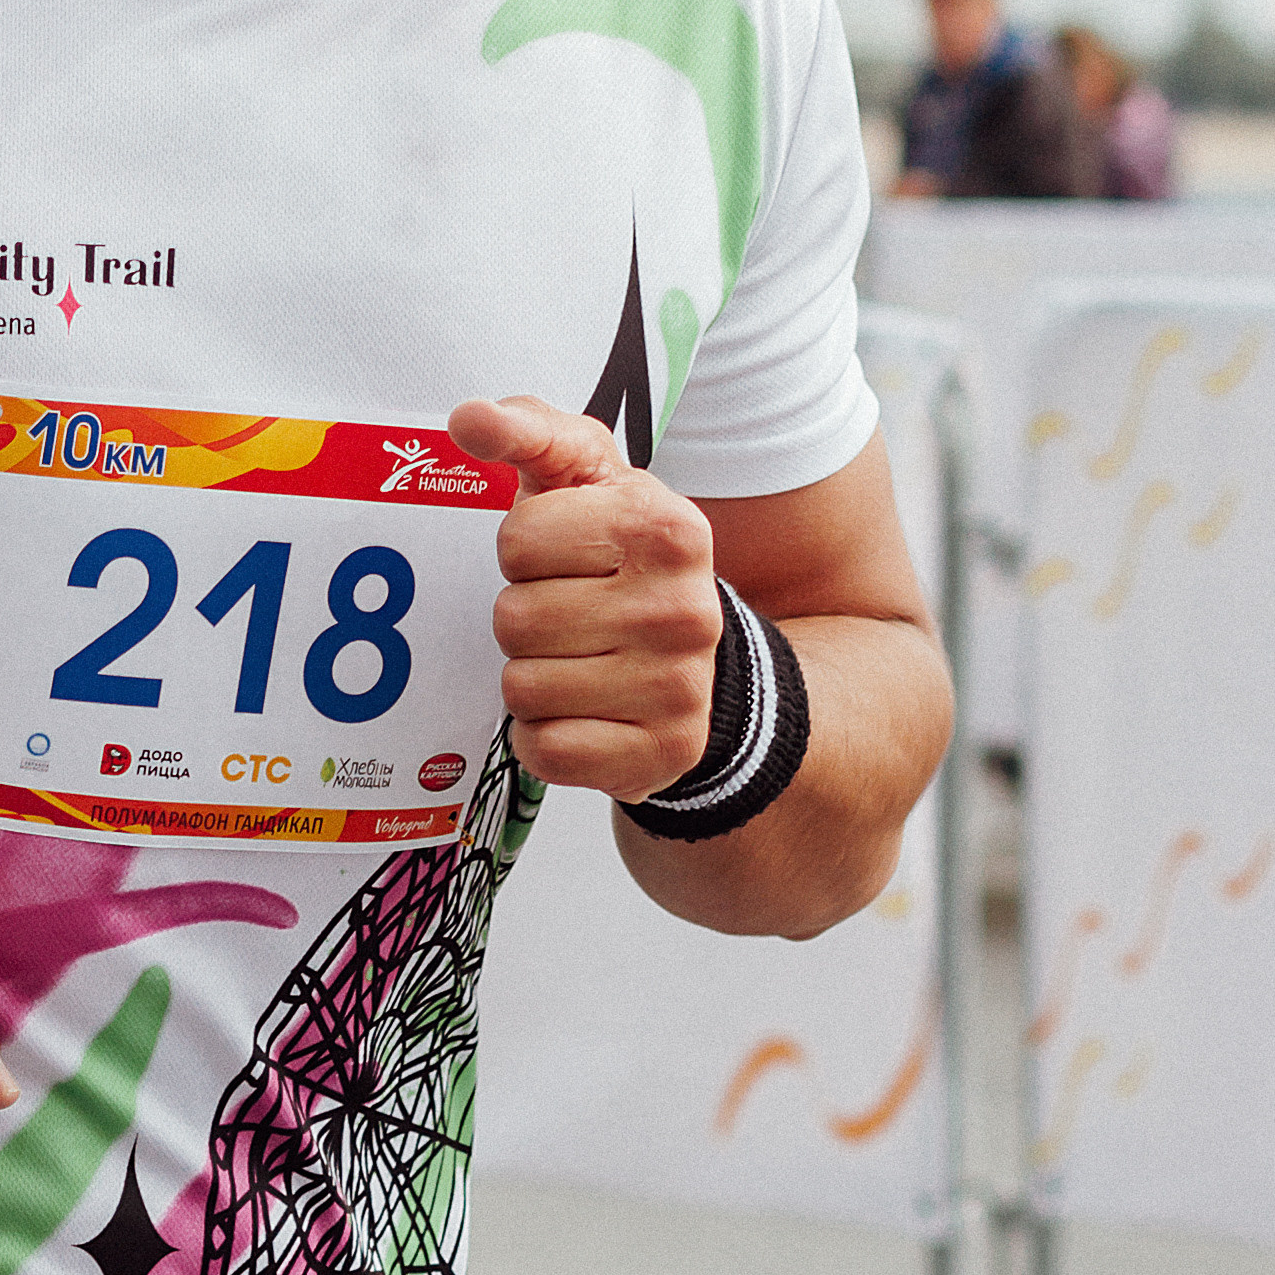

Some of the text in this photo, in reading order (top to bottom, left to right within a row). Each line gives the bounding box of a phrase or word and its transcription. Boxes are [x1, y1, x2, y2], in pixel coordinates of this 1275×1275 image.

[75, 243, 176, 288] Trail
[27, 410, 102, 472] 10
[418, 476, 488, 494] HANDICAP
[49, 527, 416, 724] 218
[138, 749, 183, 763] ДОДО
[220, 753, 293, 784] СТС
[136, 764, 191, 780] ПИЦЦА
[90, 805, 324, 834] ПОЛУМАРАФОН ГАНДИКАП
[375, 814, 434, 839] Volgograd
